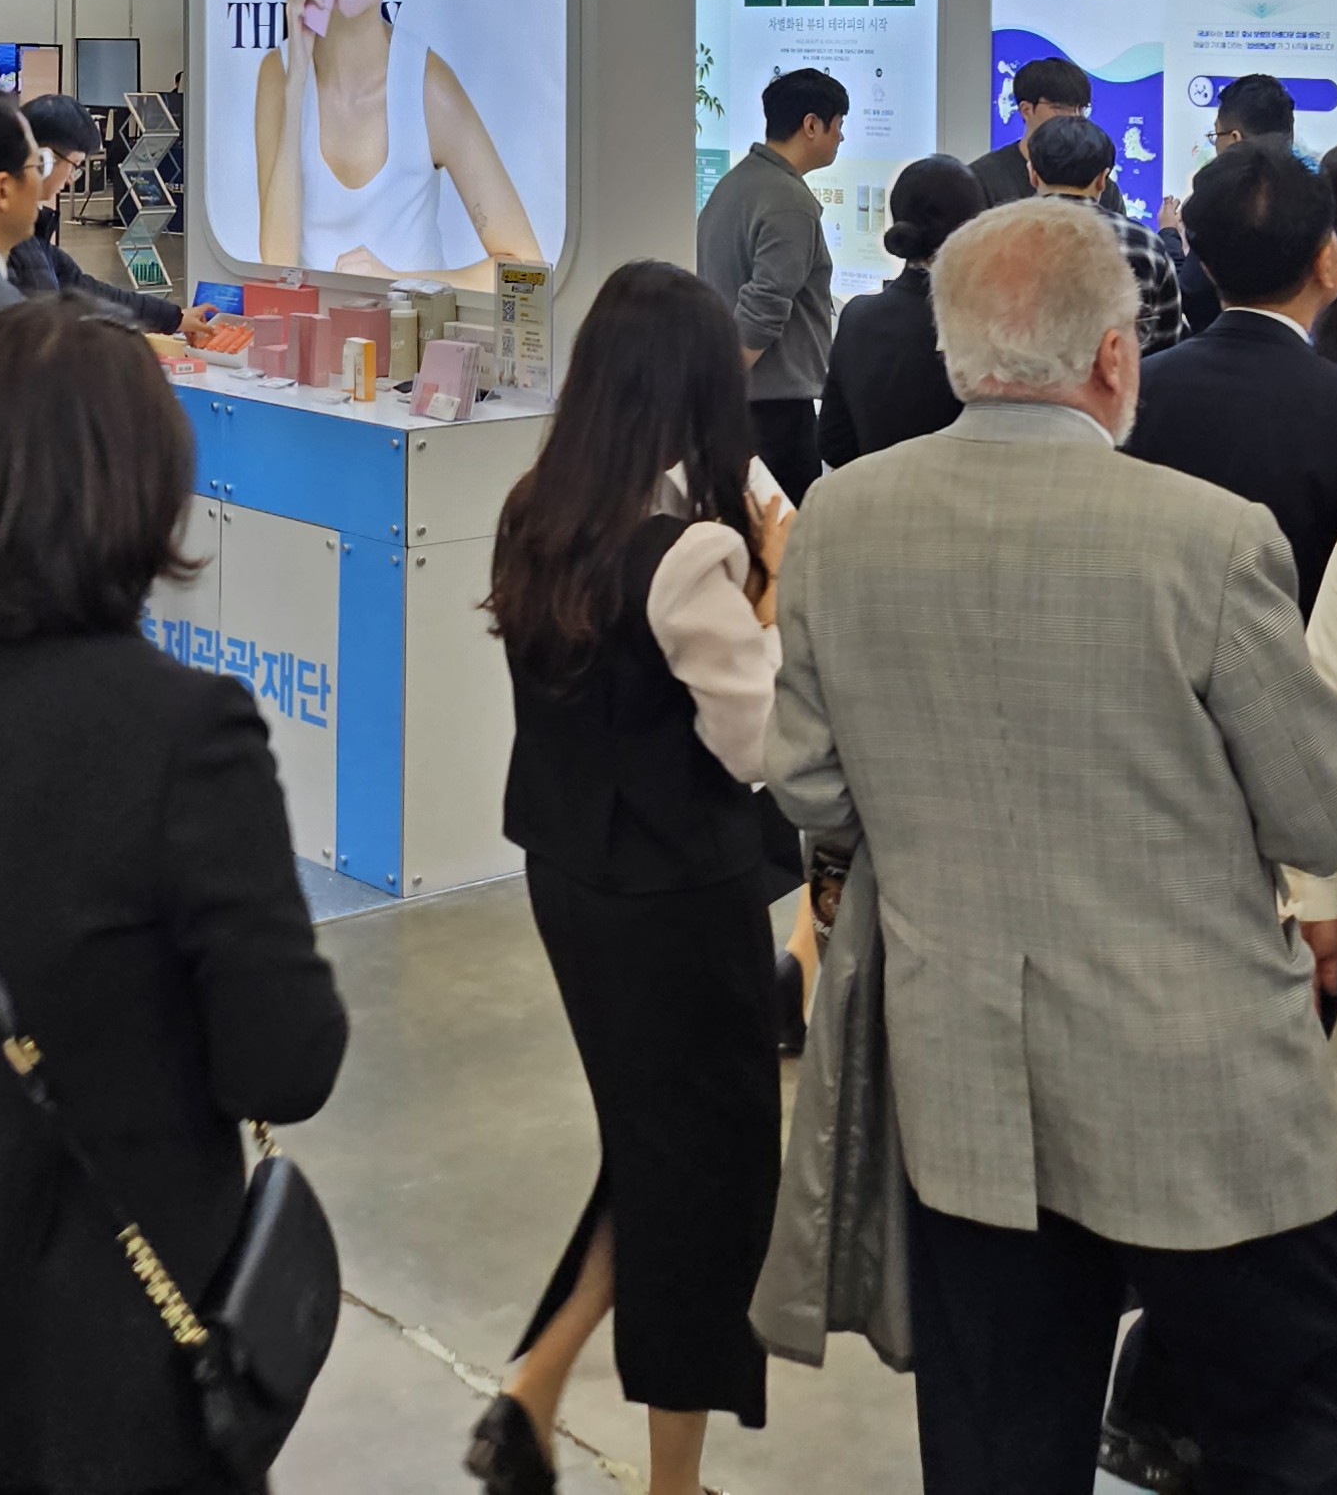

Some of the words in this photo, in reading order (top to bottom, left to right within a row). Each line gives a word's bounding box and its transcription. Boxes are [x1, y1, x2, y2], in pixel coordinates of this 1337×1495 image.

[807, 17, 825, 32] 뷰티
[828, 17, 865, 33] 테라피의
[869, 17, 888, 33] 시작
